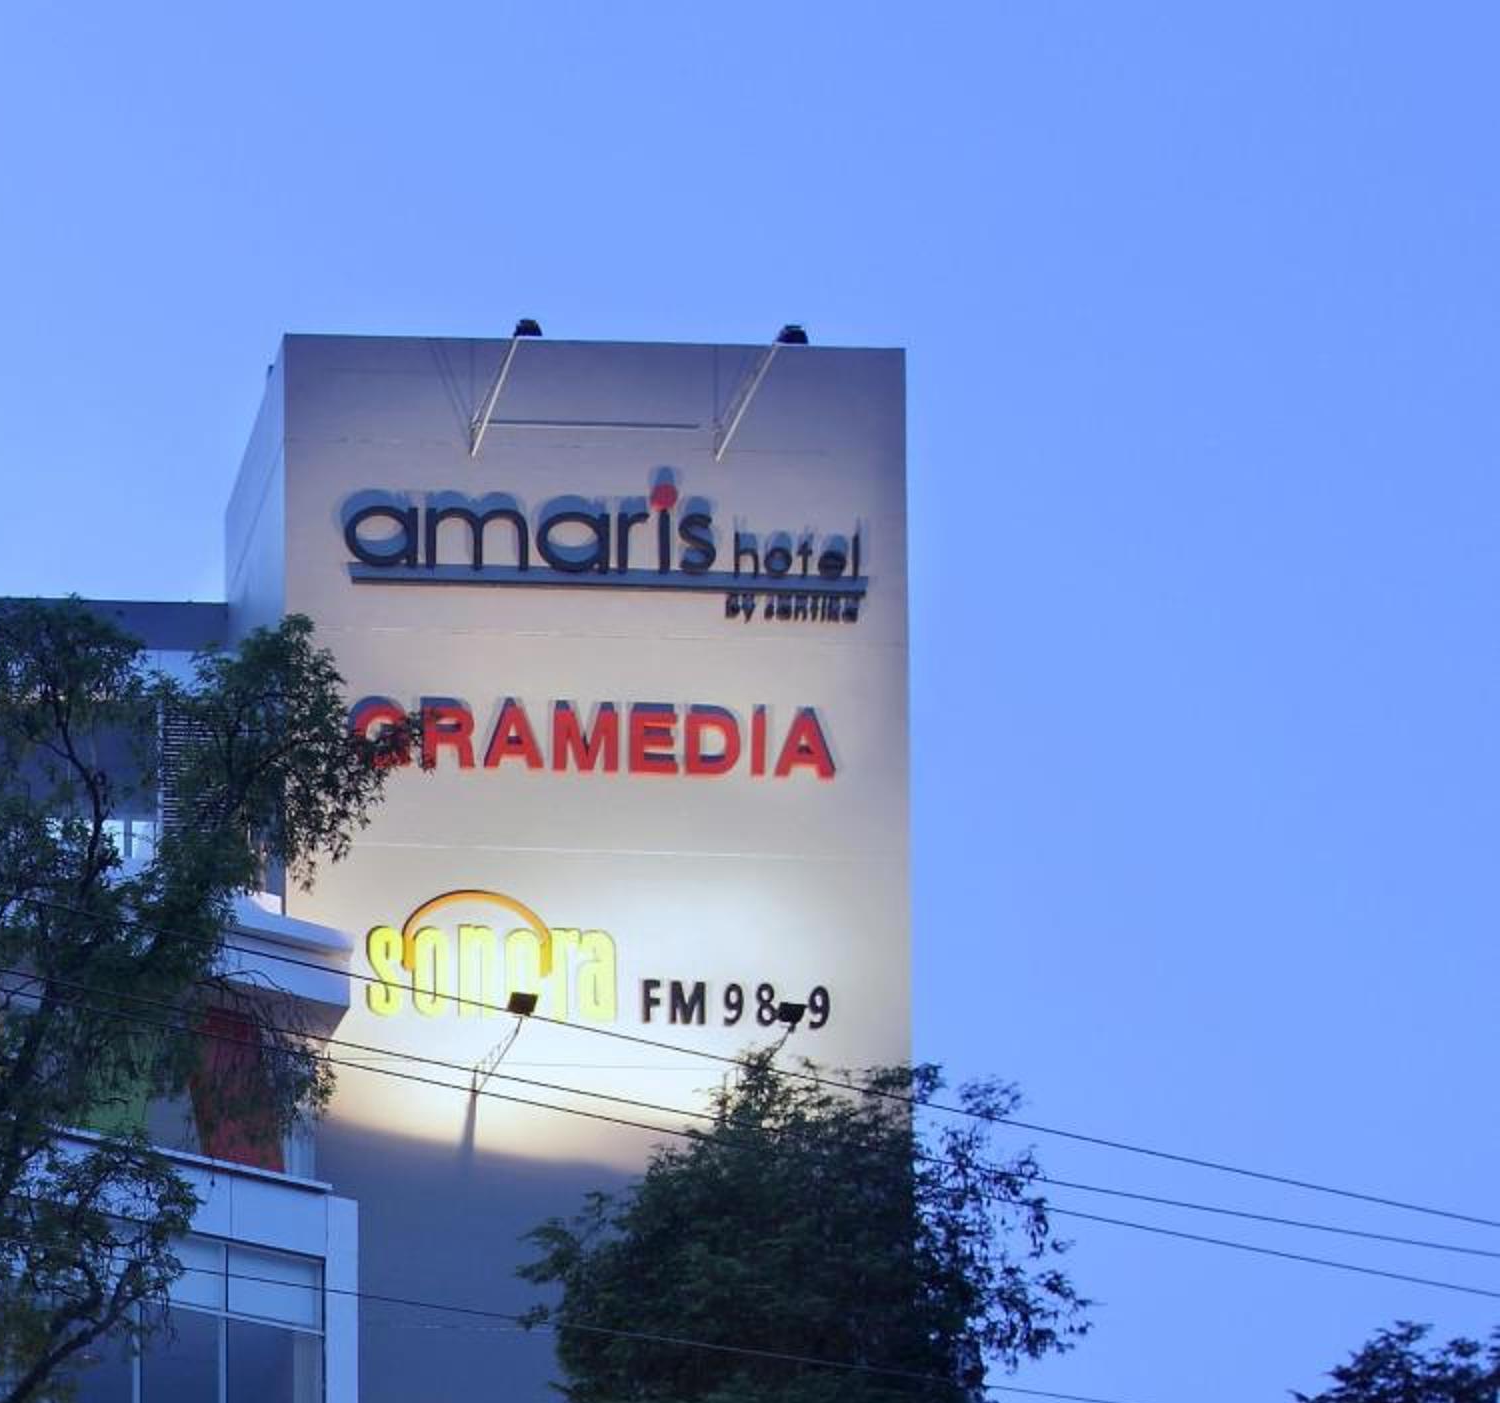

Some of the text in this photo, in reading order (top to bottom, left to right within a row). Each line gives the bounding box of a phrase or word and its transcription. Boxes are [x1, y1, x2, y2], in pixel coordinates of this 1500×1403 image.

[344, 482, 861, 581] amaris hotel
[366, 925, 831, 1030] sonora FM 989
